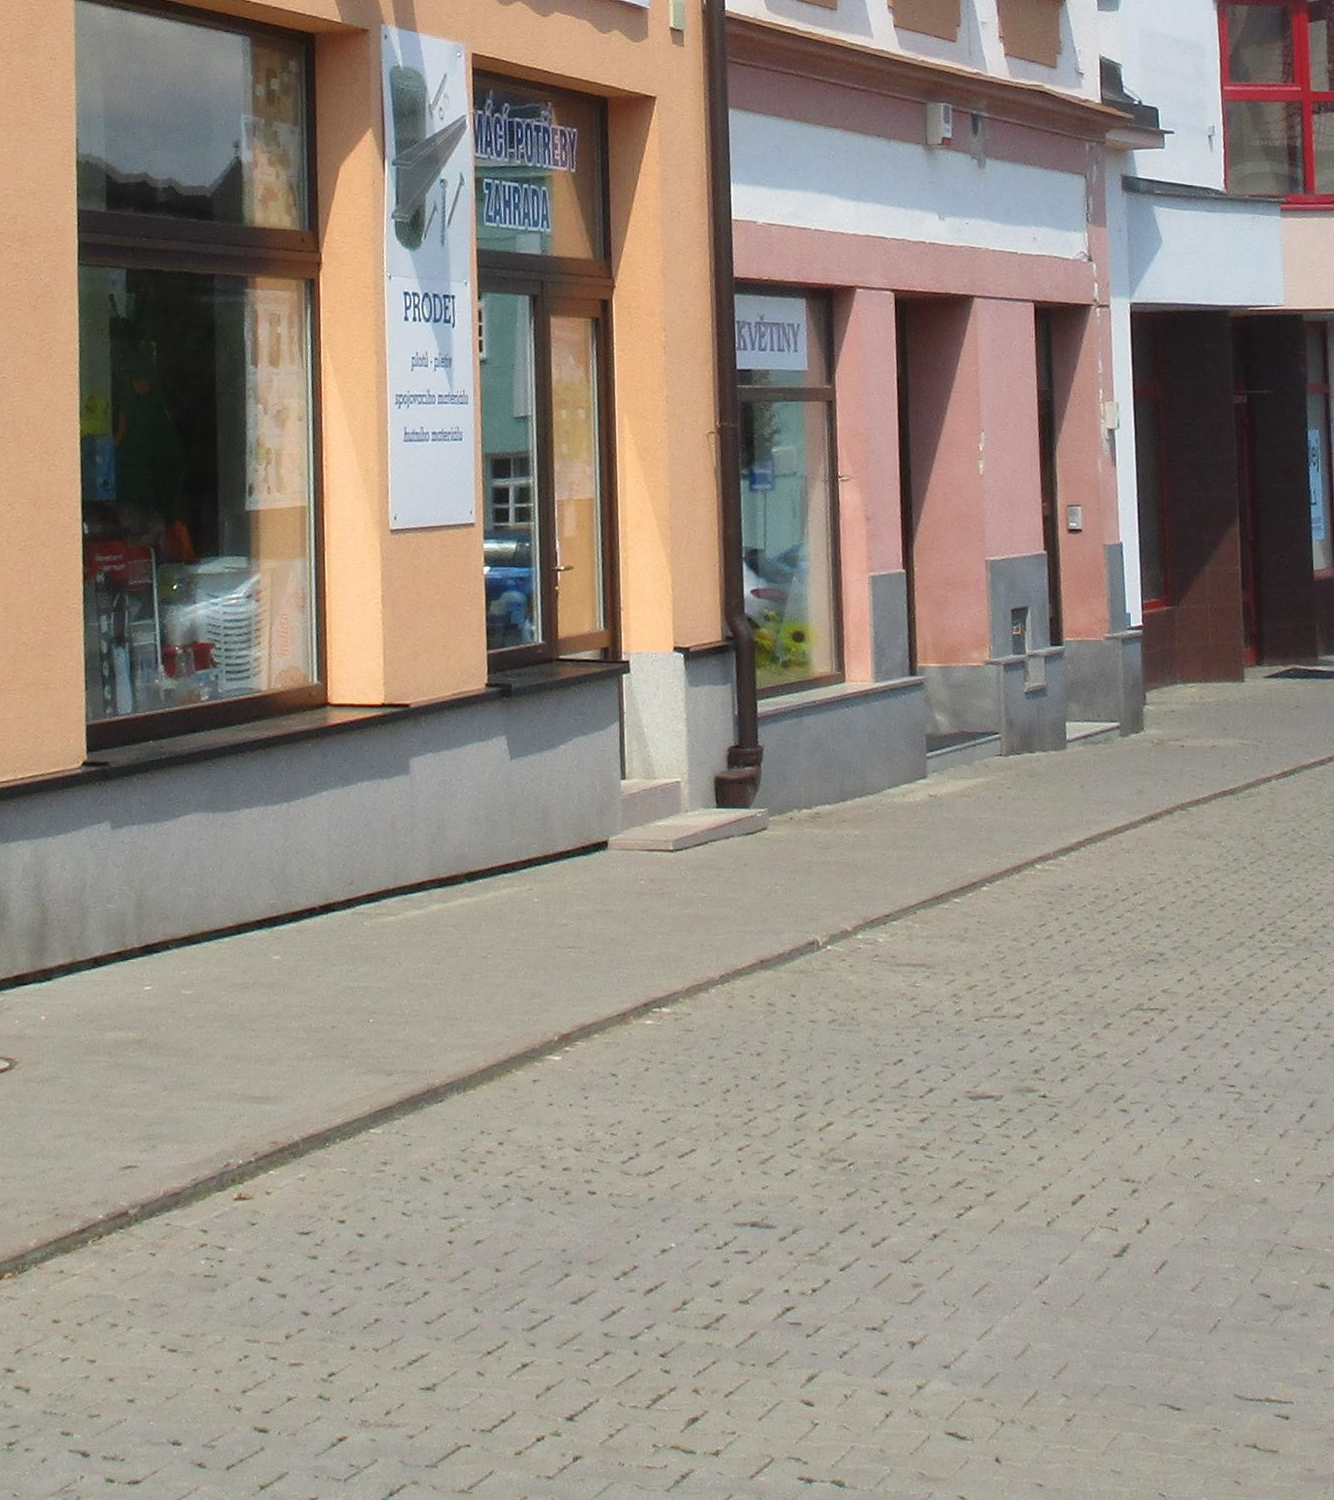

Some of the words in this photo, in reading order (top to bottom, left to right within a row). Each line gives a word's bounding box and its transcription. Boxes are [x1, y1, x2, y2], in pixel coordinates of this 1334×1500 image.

[514, 109, 578, 172] POTŘEBY
[484, 179, 551, 231] ZAHRADA
[402, 290, 456, 329] PRODEJ
[735, 313, 801, 353] KVĚTINY
